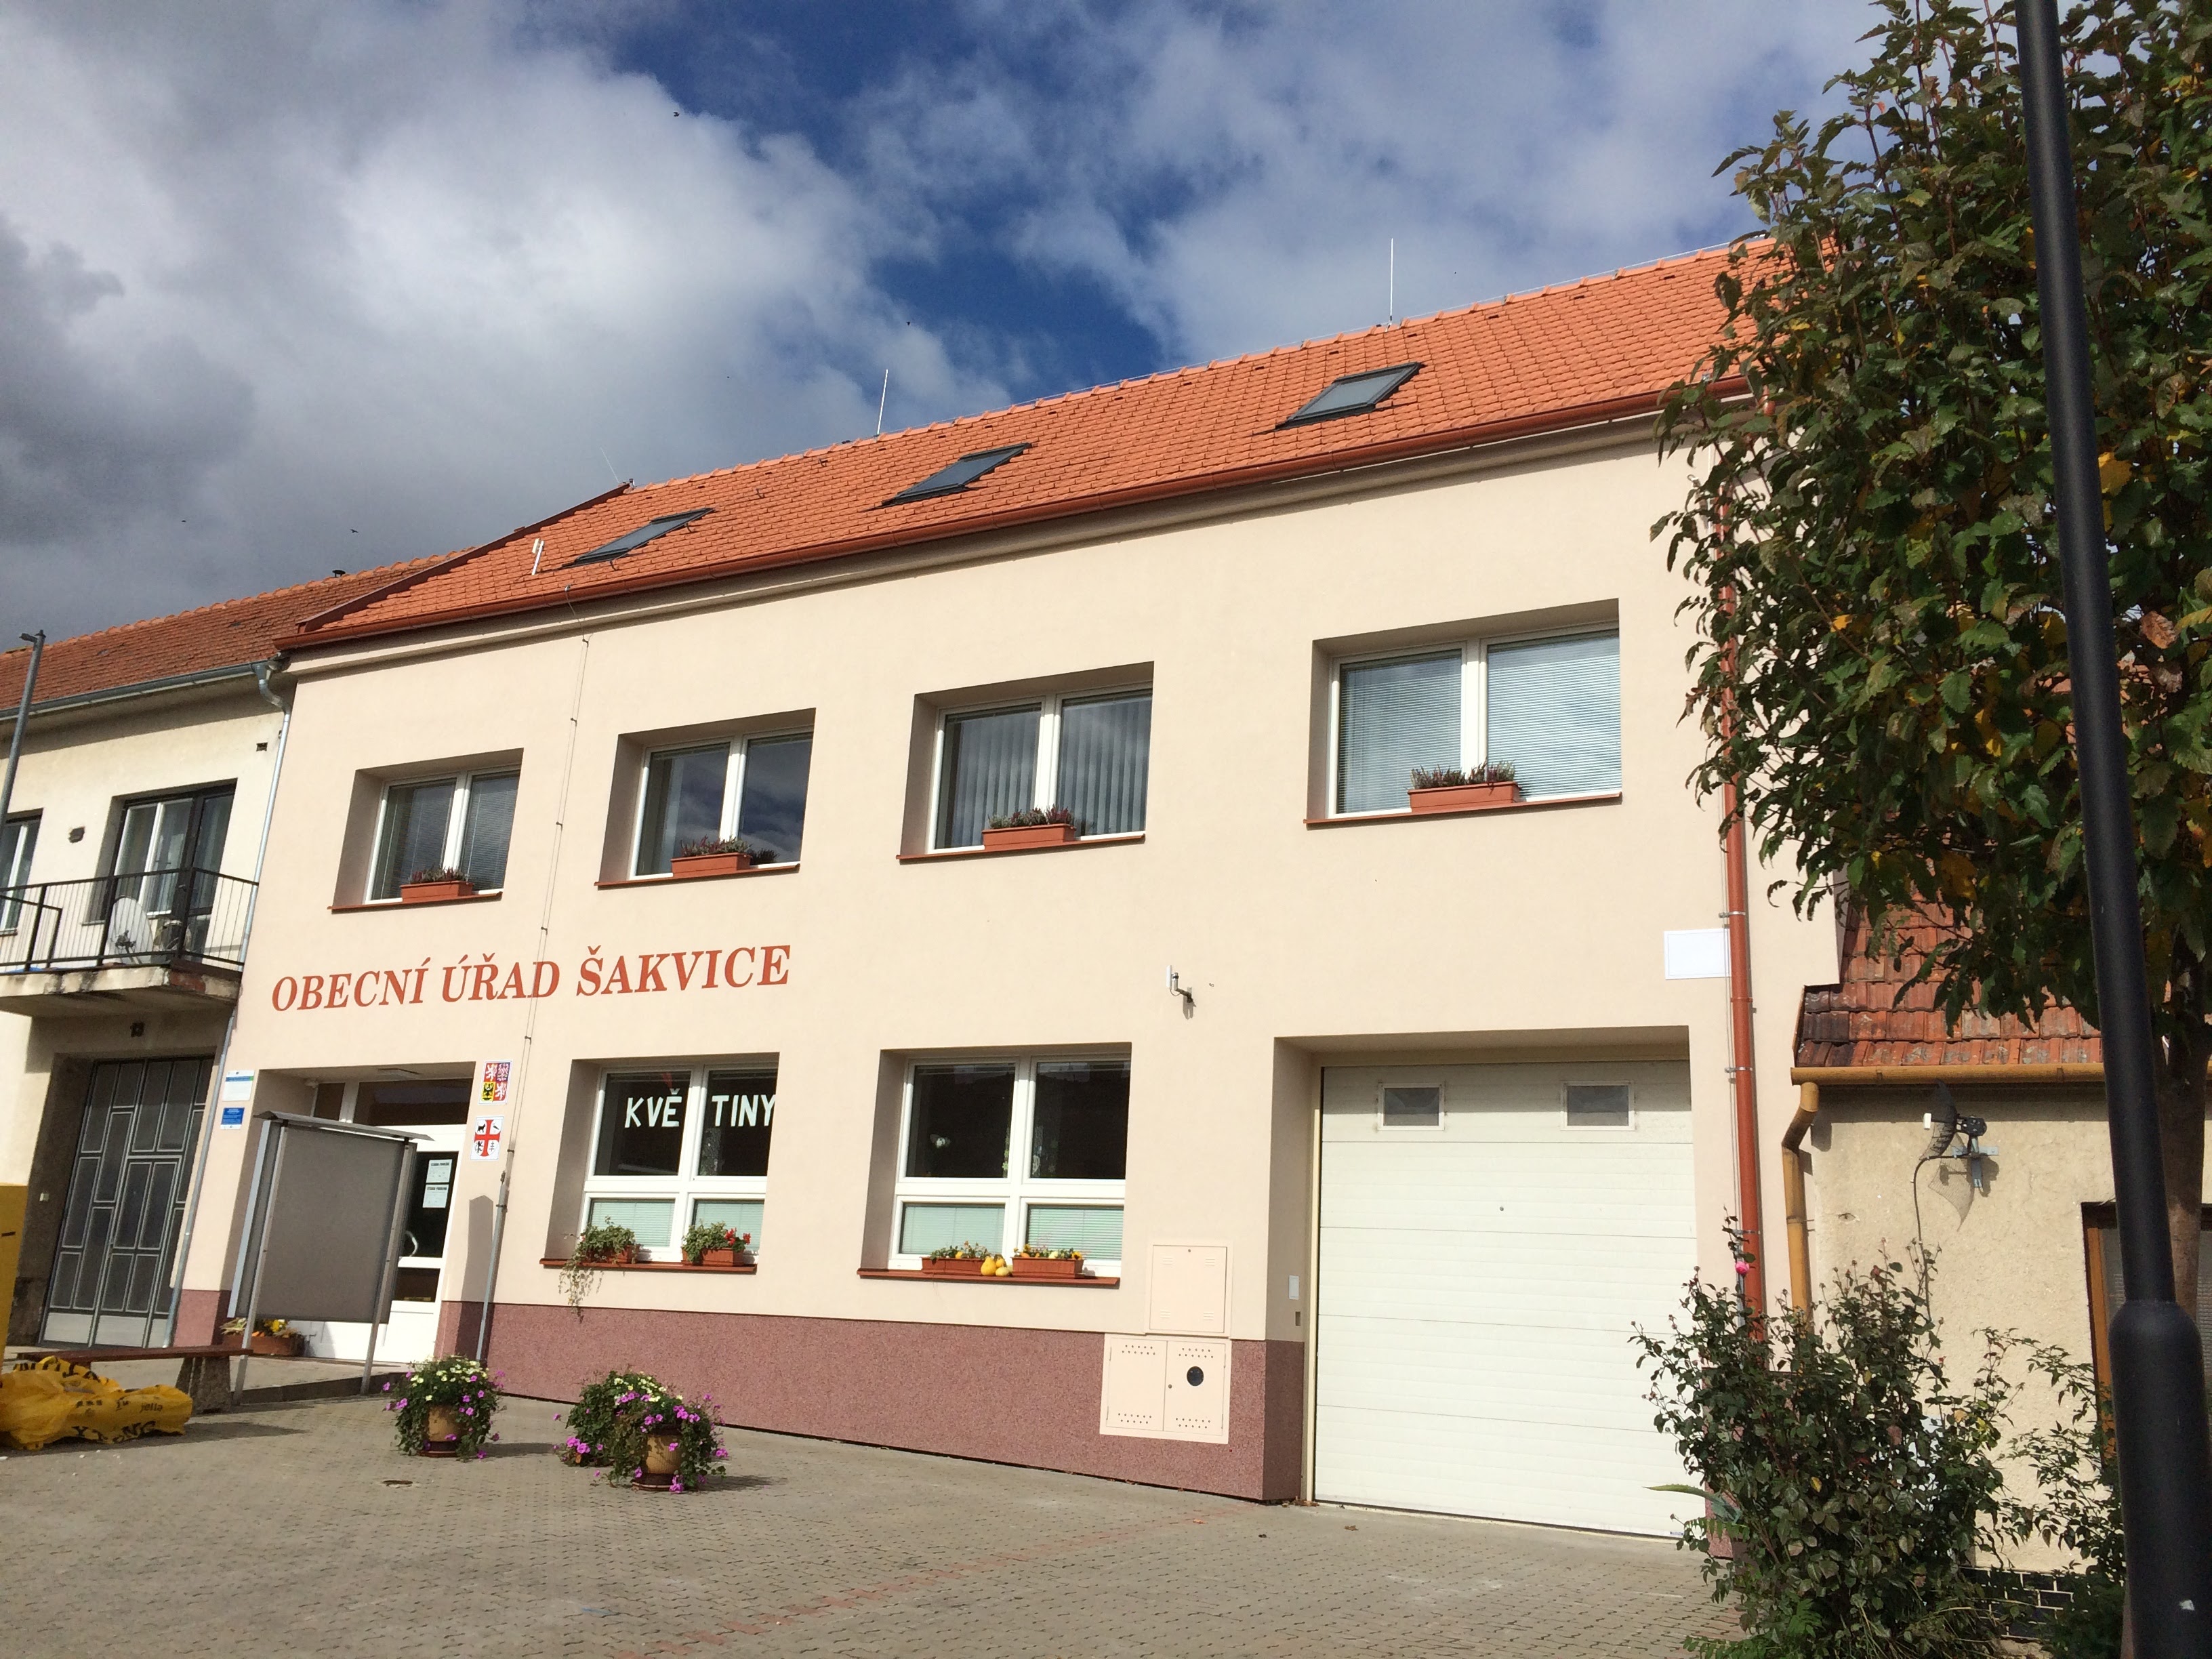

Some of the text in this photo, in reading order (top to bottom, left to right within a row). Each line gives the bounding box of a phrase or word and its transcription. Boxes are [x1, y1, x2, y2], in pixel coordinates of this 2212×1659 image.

[272, 945, 791, 1011] OBECNÍ ÚŘAD ŠAKVICE
